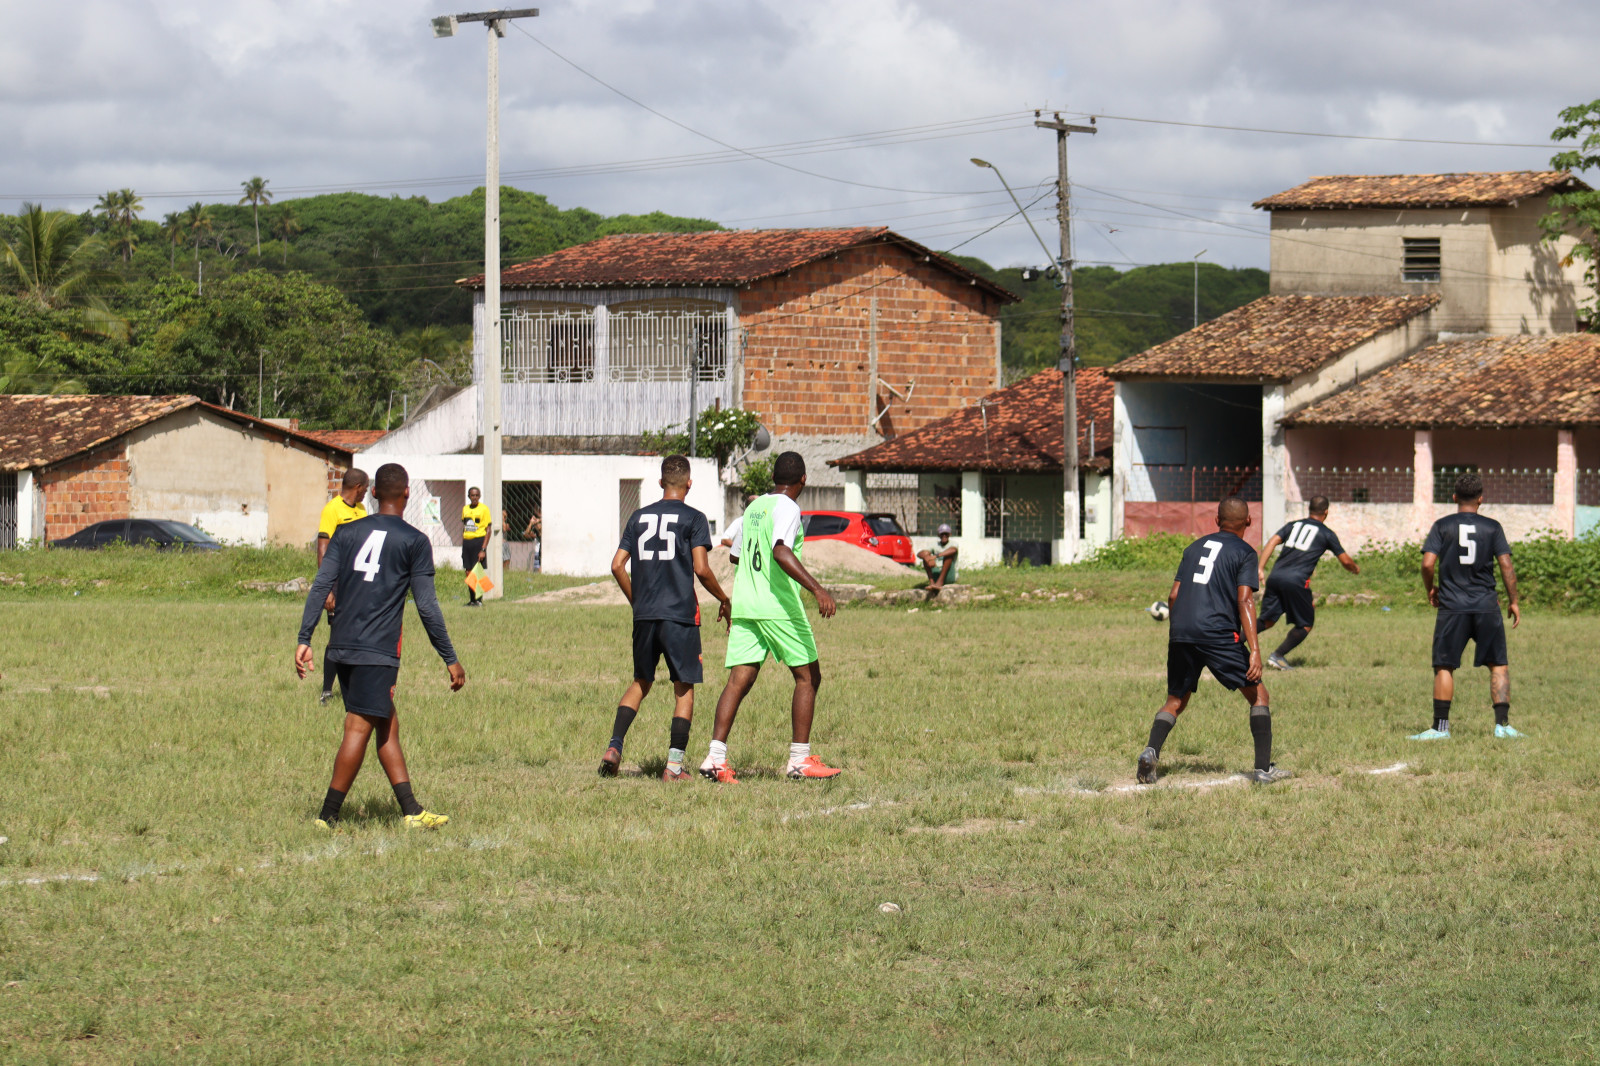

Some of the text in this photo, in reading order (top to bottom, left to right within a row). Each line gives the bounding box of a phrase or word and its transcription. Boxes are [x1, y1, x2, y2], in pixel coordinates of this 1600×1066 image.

[354, 530, 387, 582] 4
[638, 514, 679, 560] 25
[747, 537, 762, 572] 16
[1285, 521, 1319, 551] 10
[1459, 524, 1476, 564] 5
[1193, 540, 1223, 584] 3
